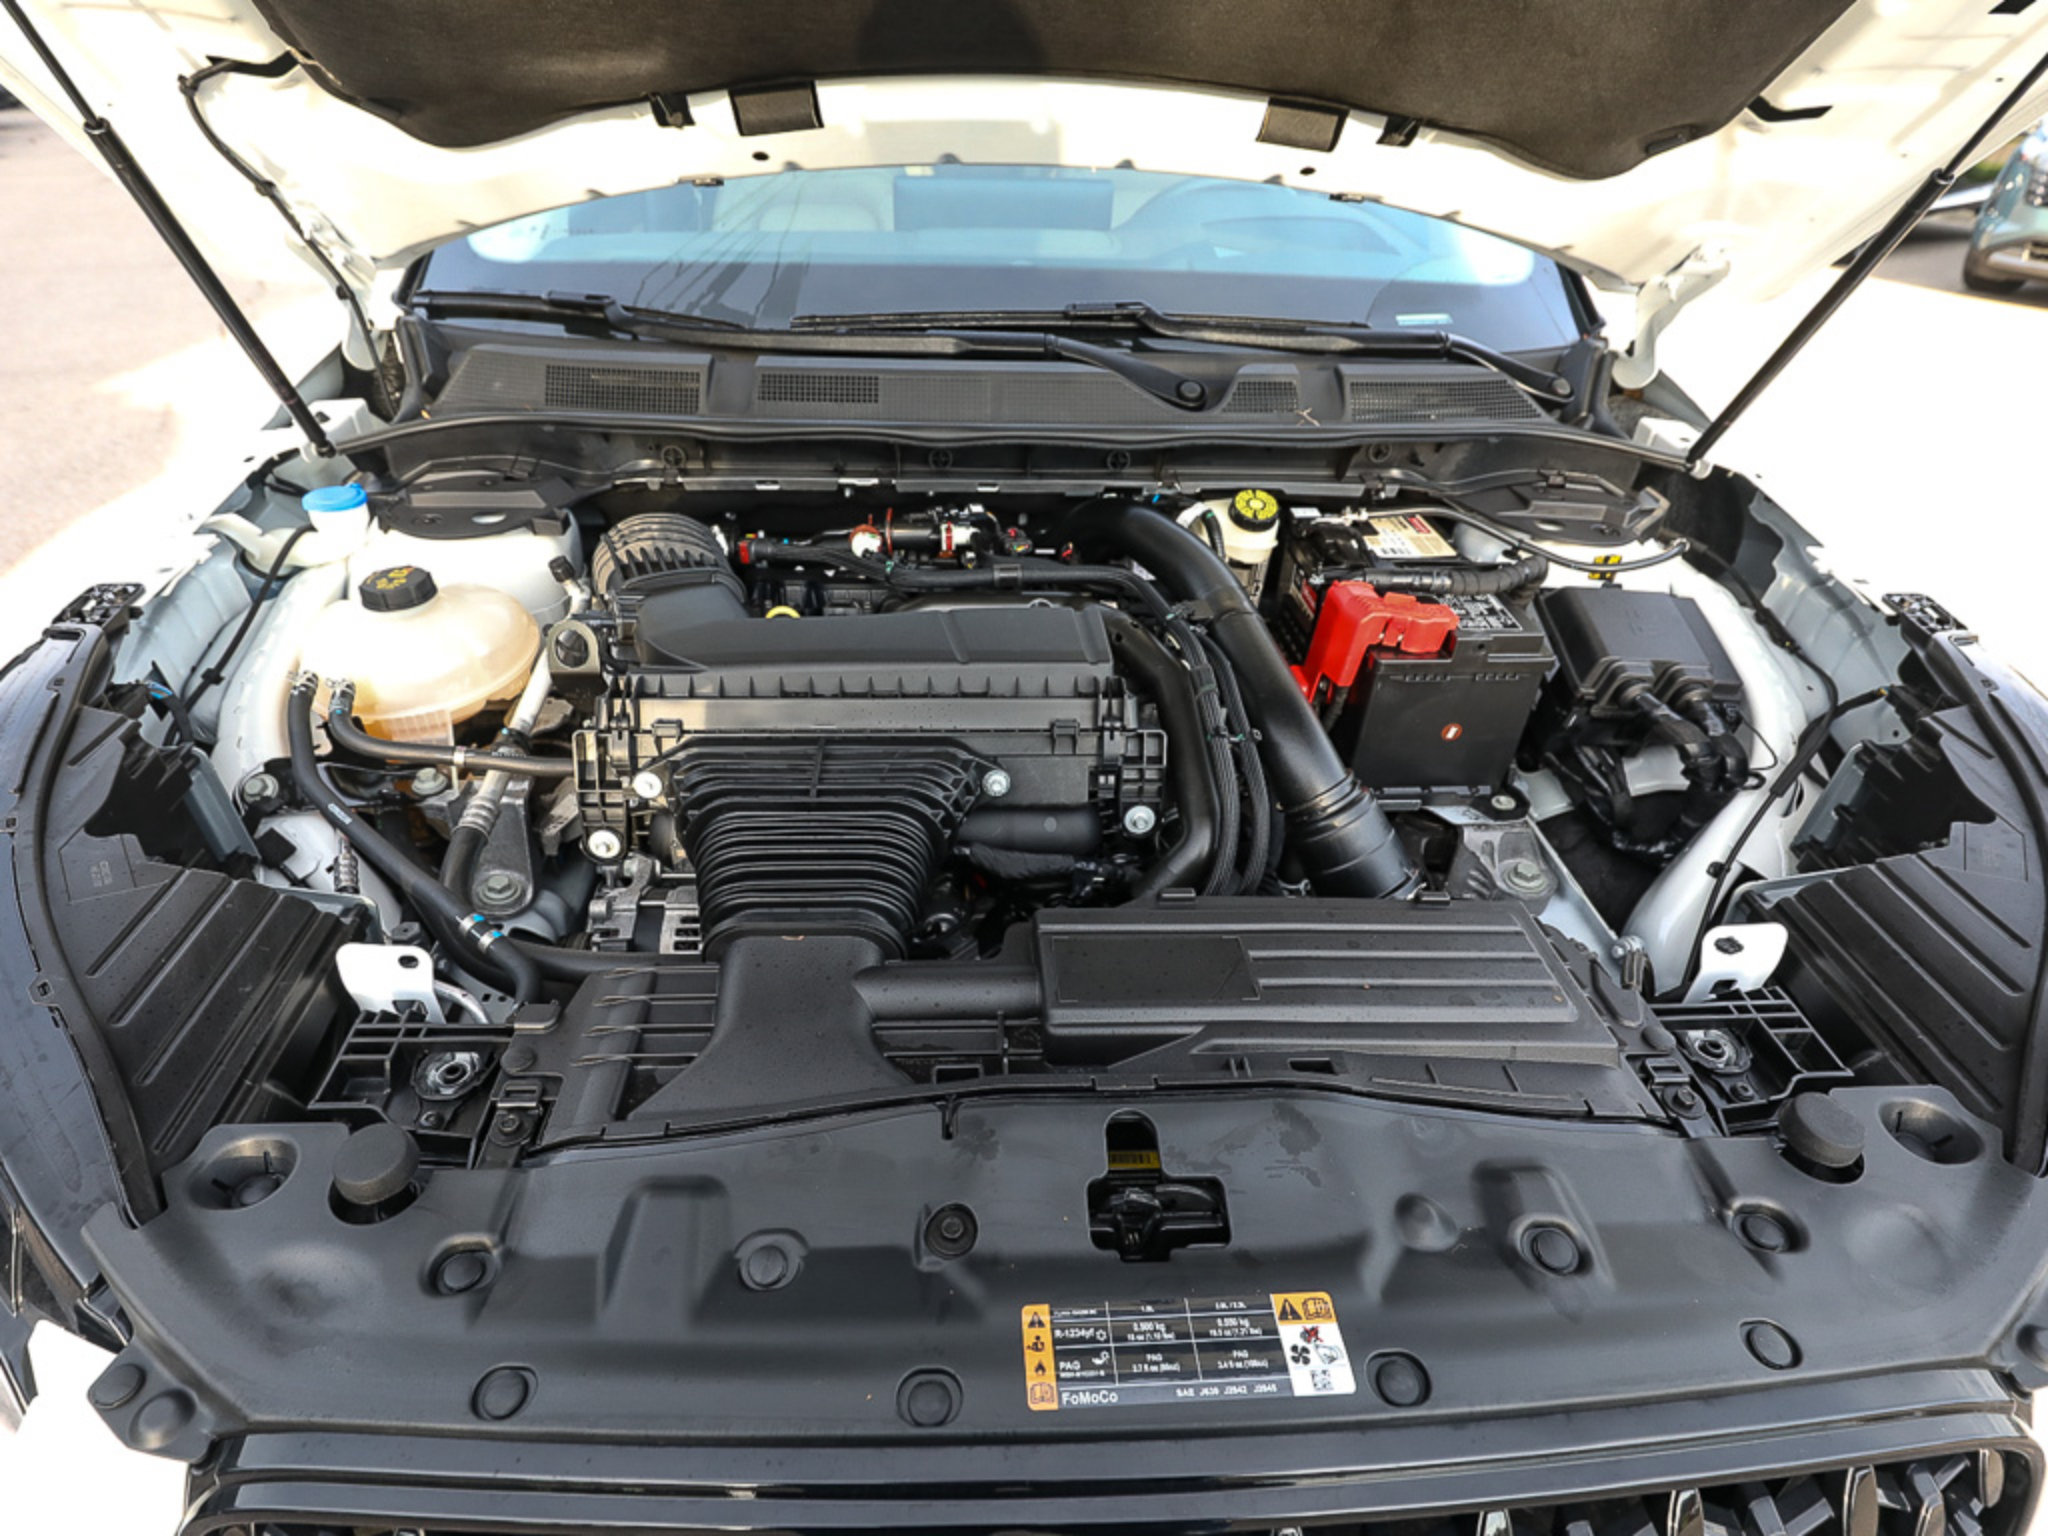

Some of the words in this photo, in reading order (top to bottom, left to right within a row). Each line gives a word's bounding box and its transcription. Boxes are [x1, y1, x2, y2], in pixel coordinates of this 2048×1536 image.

[1059, 1360, 1081, 1371] PAG
[1175, 1387, 1195, 1397] SAE
[1062, 1390, 1119, 1406] FoMoCo
